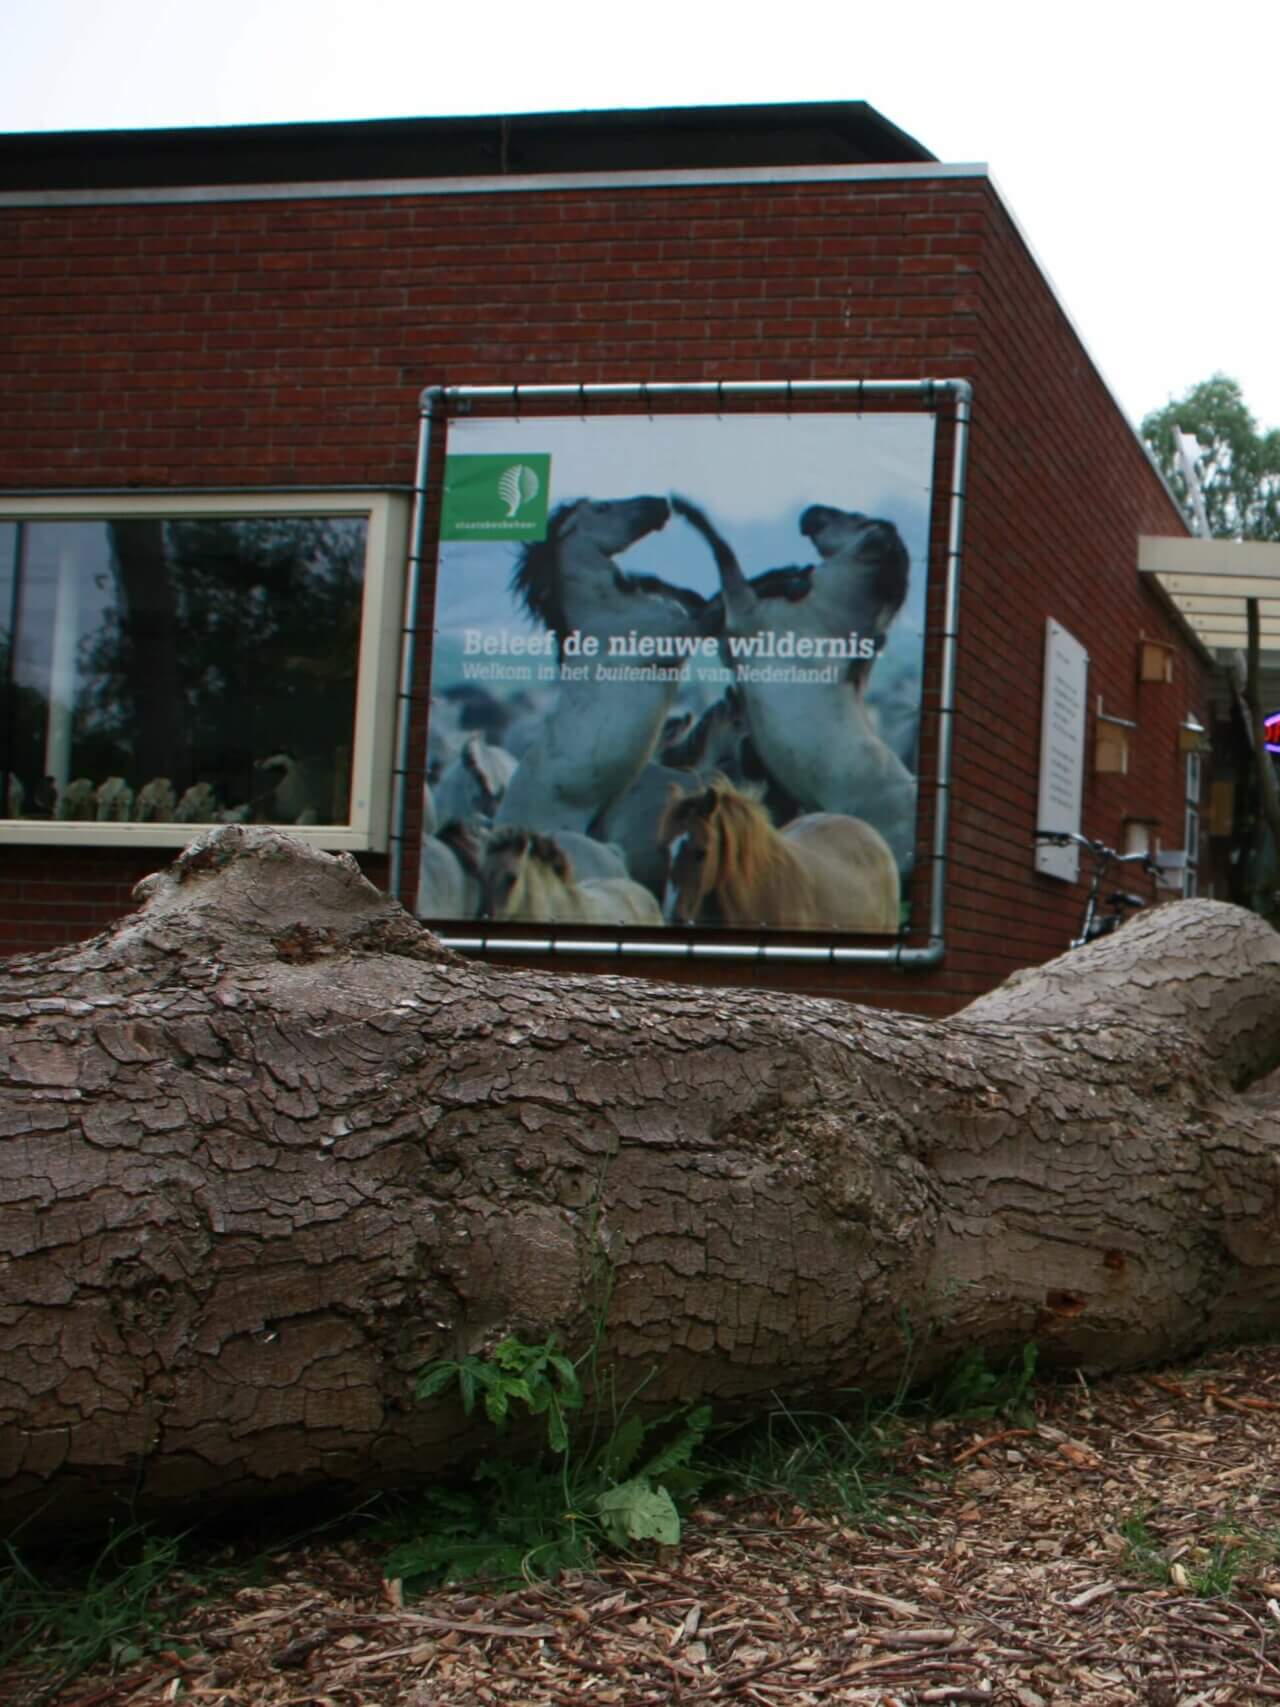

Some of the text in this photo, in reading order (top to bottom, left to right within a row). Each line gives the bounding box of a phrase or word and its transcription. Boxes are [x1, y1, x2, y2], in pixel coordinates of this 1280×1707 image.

[463, 629, 884, 660] Beleef de nieuwe wildernis.
[463, 663, 838, 684] Welkom in het buitenland van Nederland!
